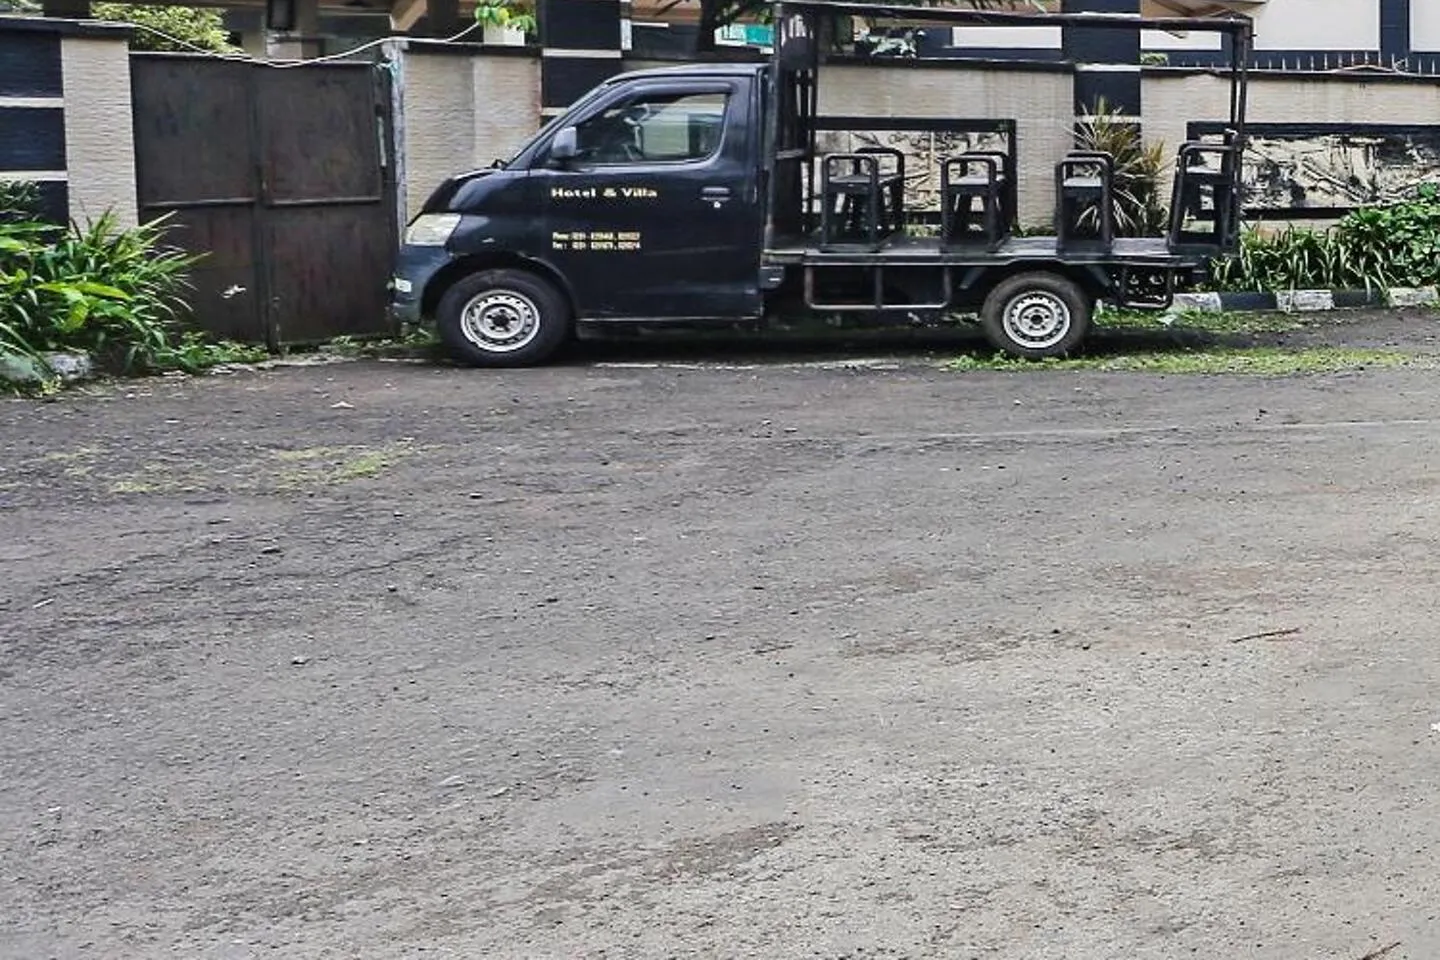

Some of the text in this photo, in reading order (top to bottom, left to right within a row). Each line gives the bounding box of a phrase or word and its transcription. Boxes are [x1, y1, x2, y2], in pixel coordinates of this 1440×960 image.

[551, 188, 657, 198] Hotel & Villa
